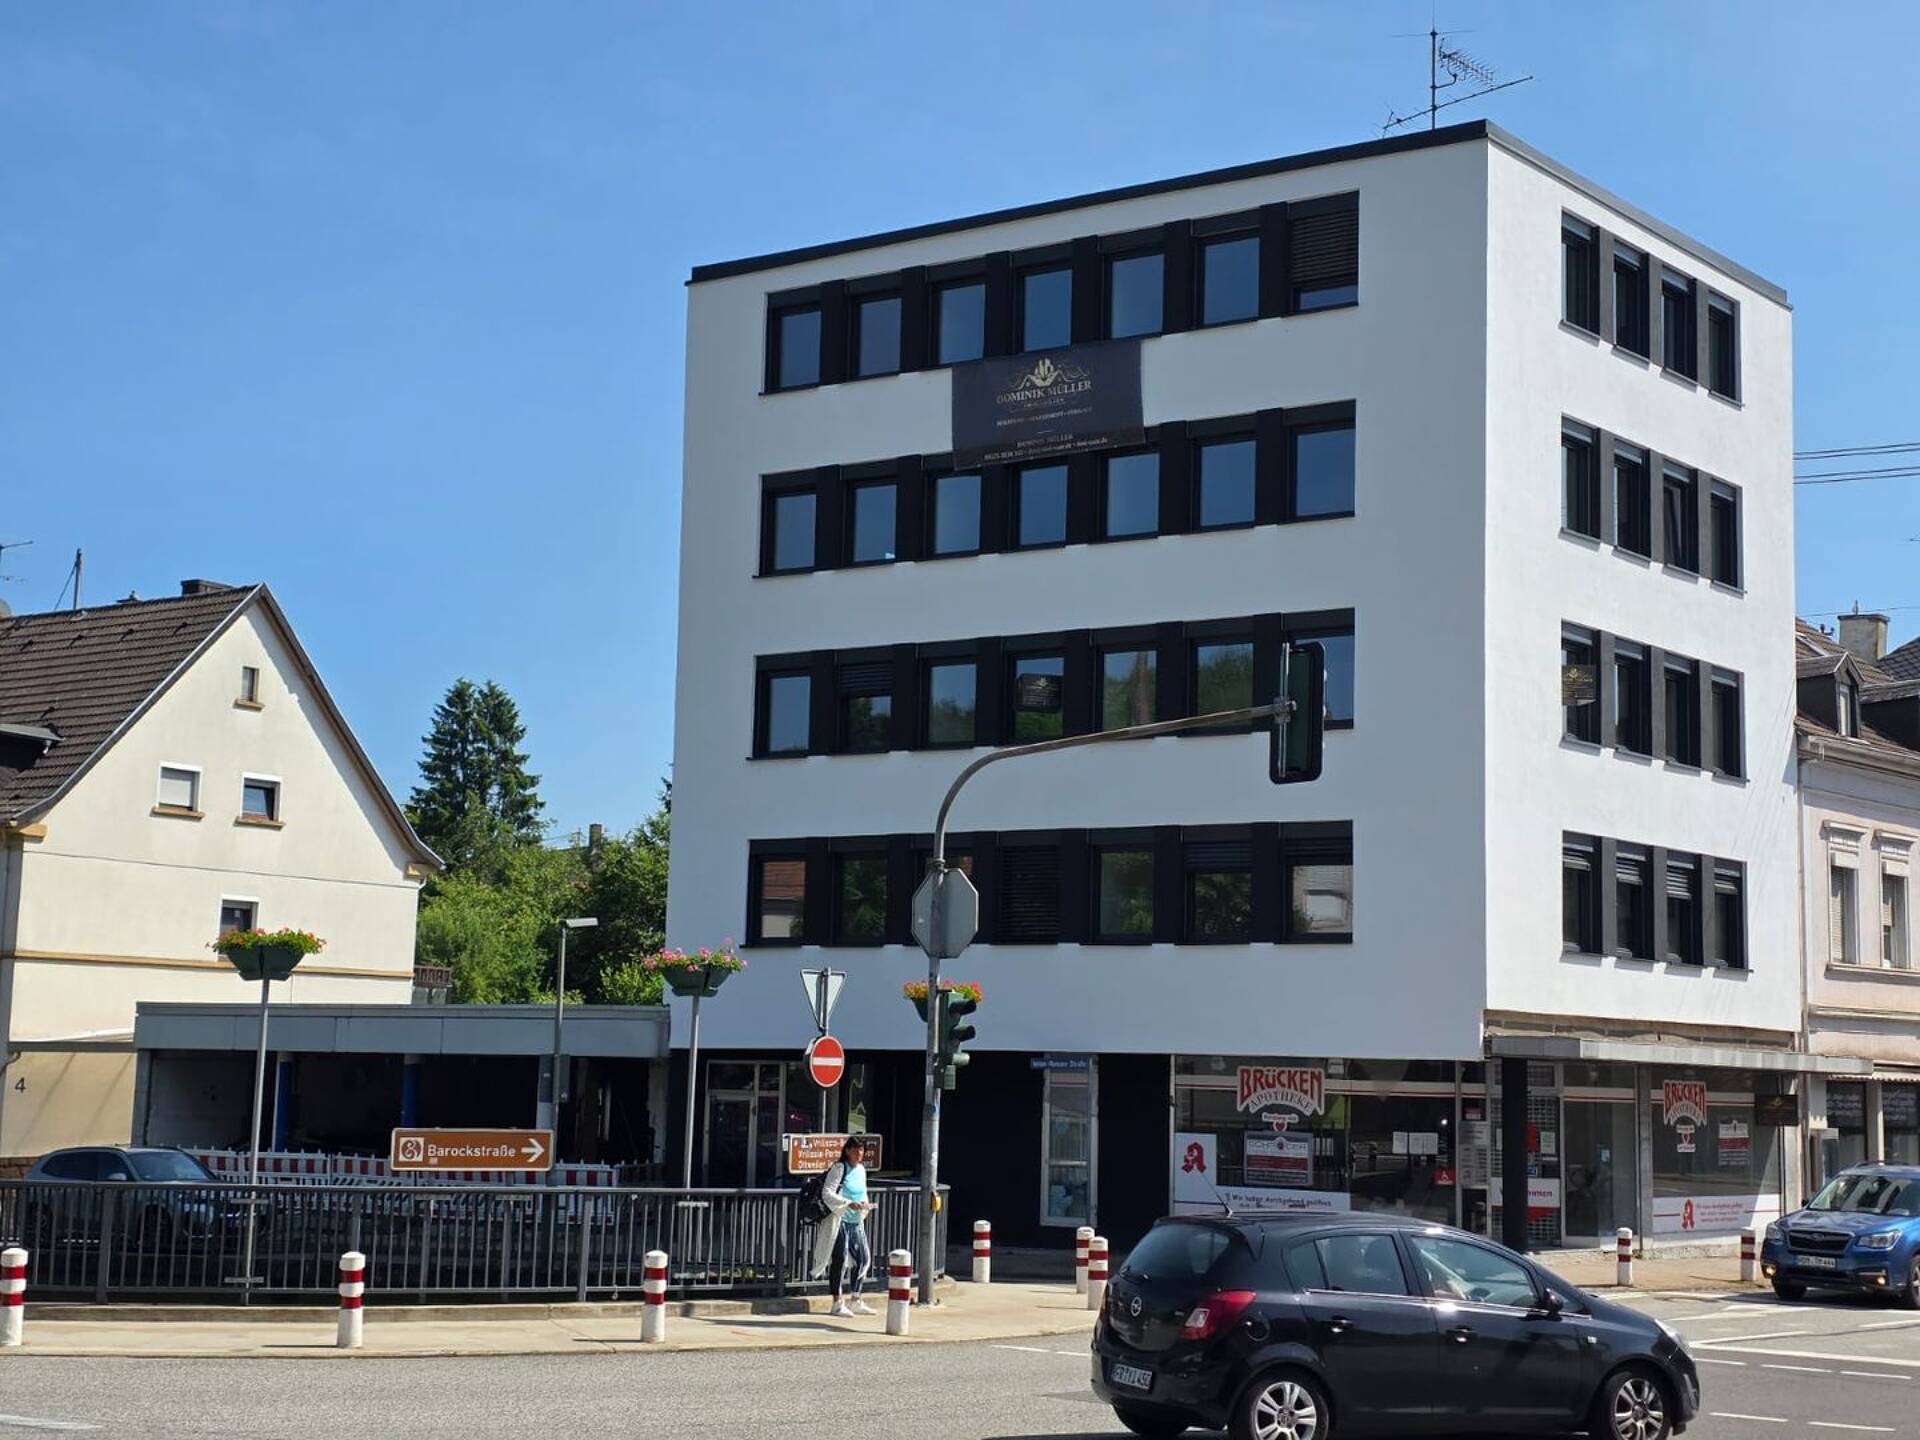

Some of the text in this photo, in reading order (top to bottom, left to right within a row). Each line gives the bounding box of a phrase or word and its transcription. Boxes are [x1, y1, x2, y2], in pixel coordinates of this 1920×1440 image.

[1048, 380, 1092, 396] MÜLLER
[15, 1077, 27, 1094] 4
[427, 1144, 516, 1157] Barockstraße
